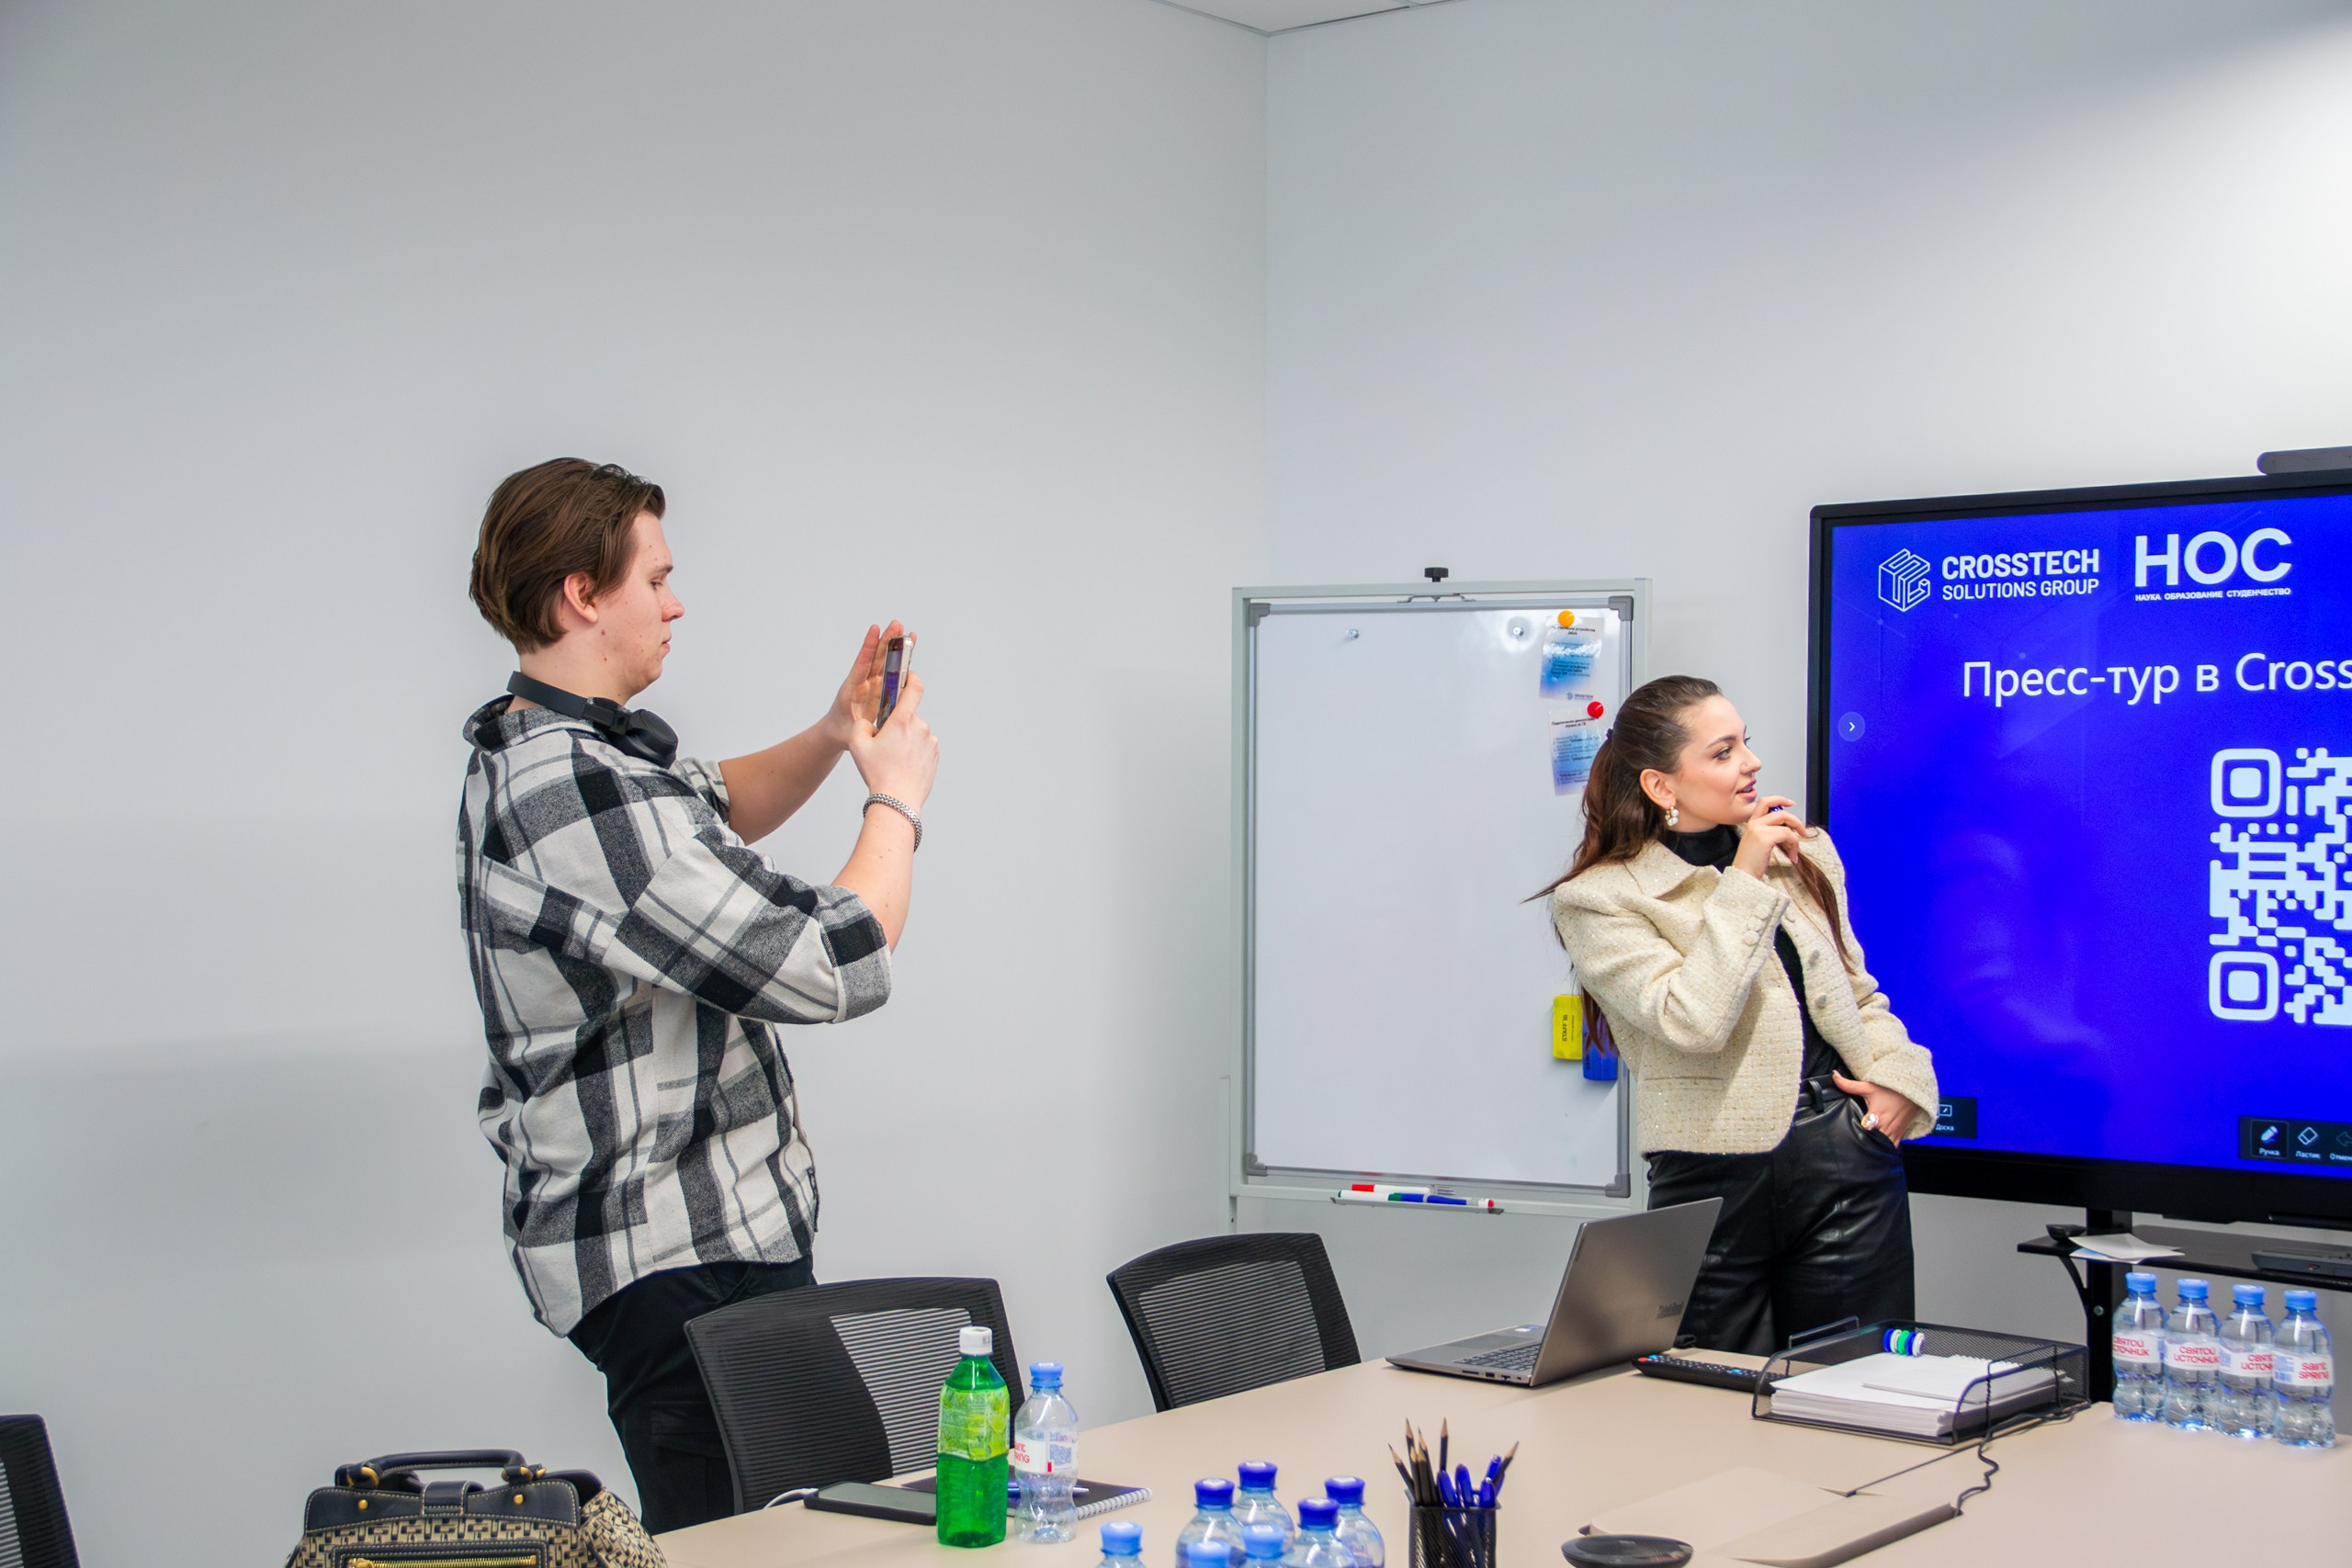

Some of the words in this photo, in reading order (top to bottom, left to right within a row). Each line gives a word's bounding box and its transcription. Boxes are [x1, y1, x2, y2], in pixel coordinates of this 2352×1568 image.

[1941, 548, 2099, 581] CROSSTECH
[2135, 527, 2292, 587] НОС
[1942, 581, 2037, 601] SOLUTIONS
[2040, 578, 2099, 596] GROUP
[2165, 591, 2223, 600] ОБРАЗОВАНИЕ
[2226, 587, 2291, 598] СТУДЕНЧЕСТВО
[1963, 661, 2179, 707] Пресс-тур
[2197, 664, 2220, 692] в
[2259, 1147, 2280, 1156] Ручка
[2295, 1150, 2321, 1159] Ластик
